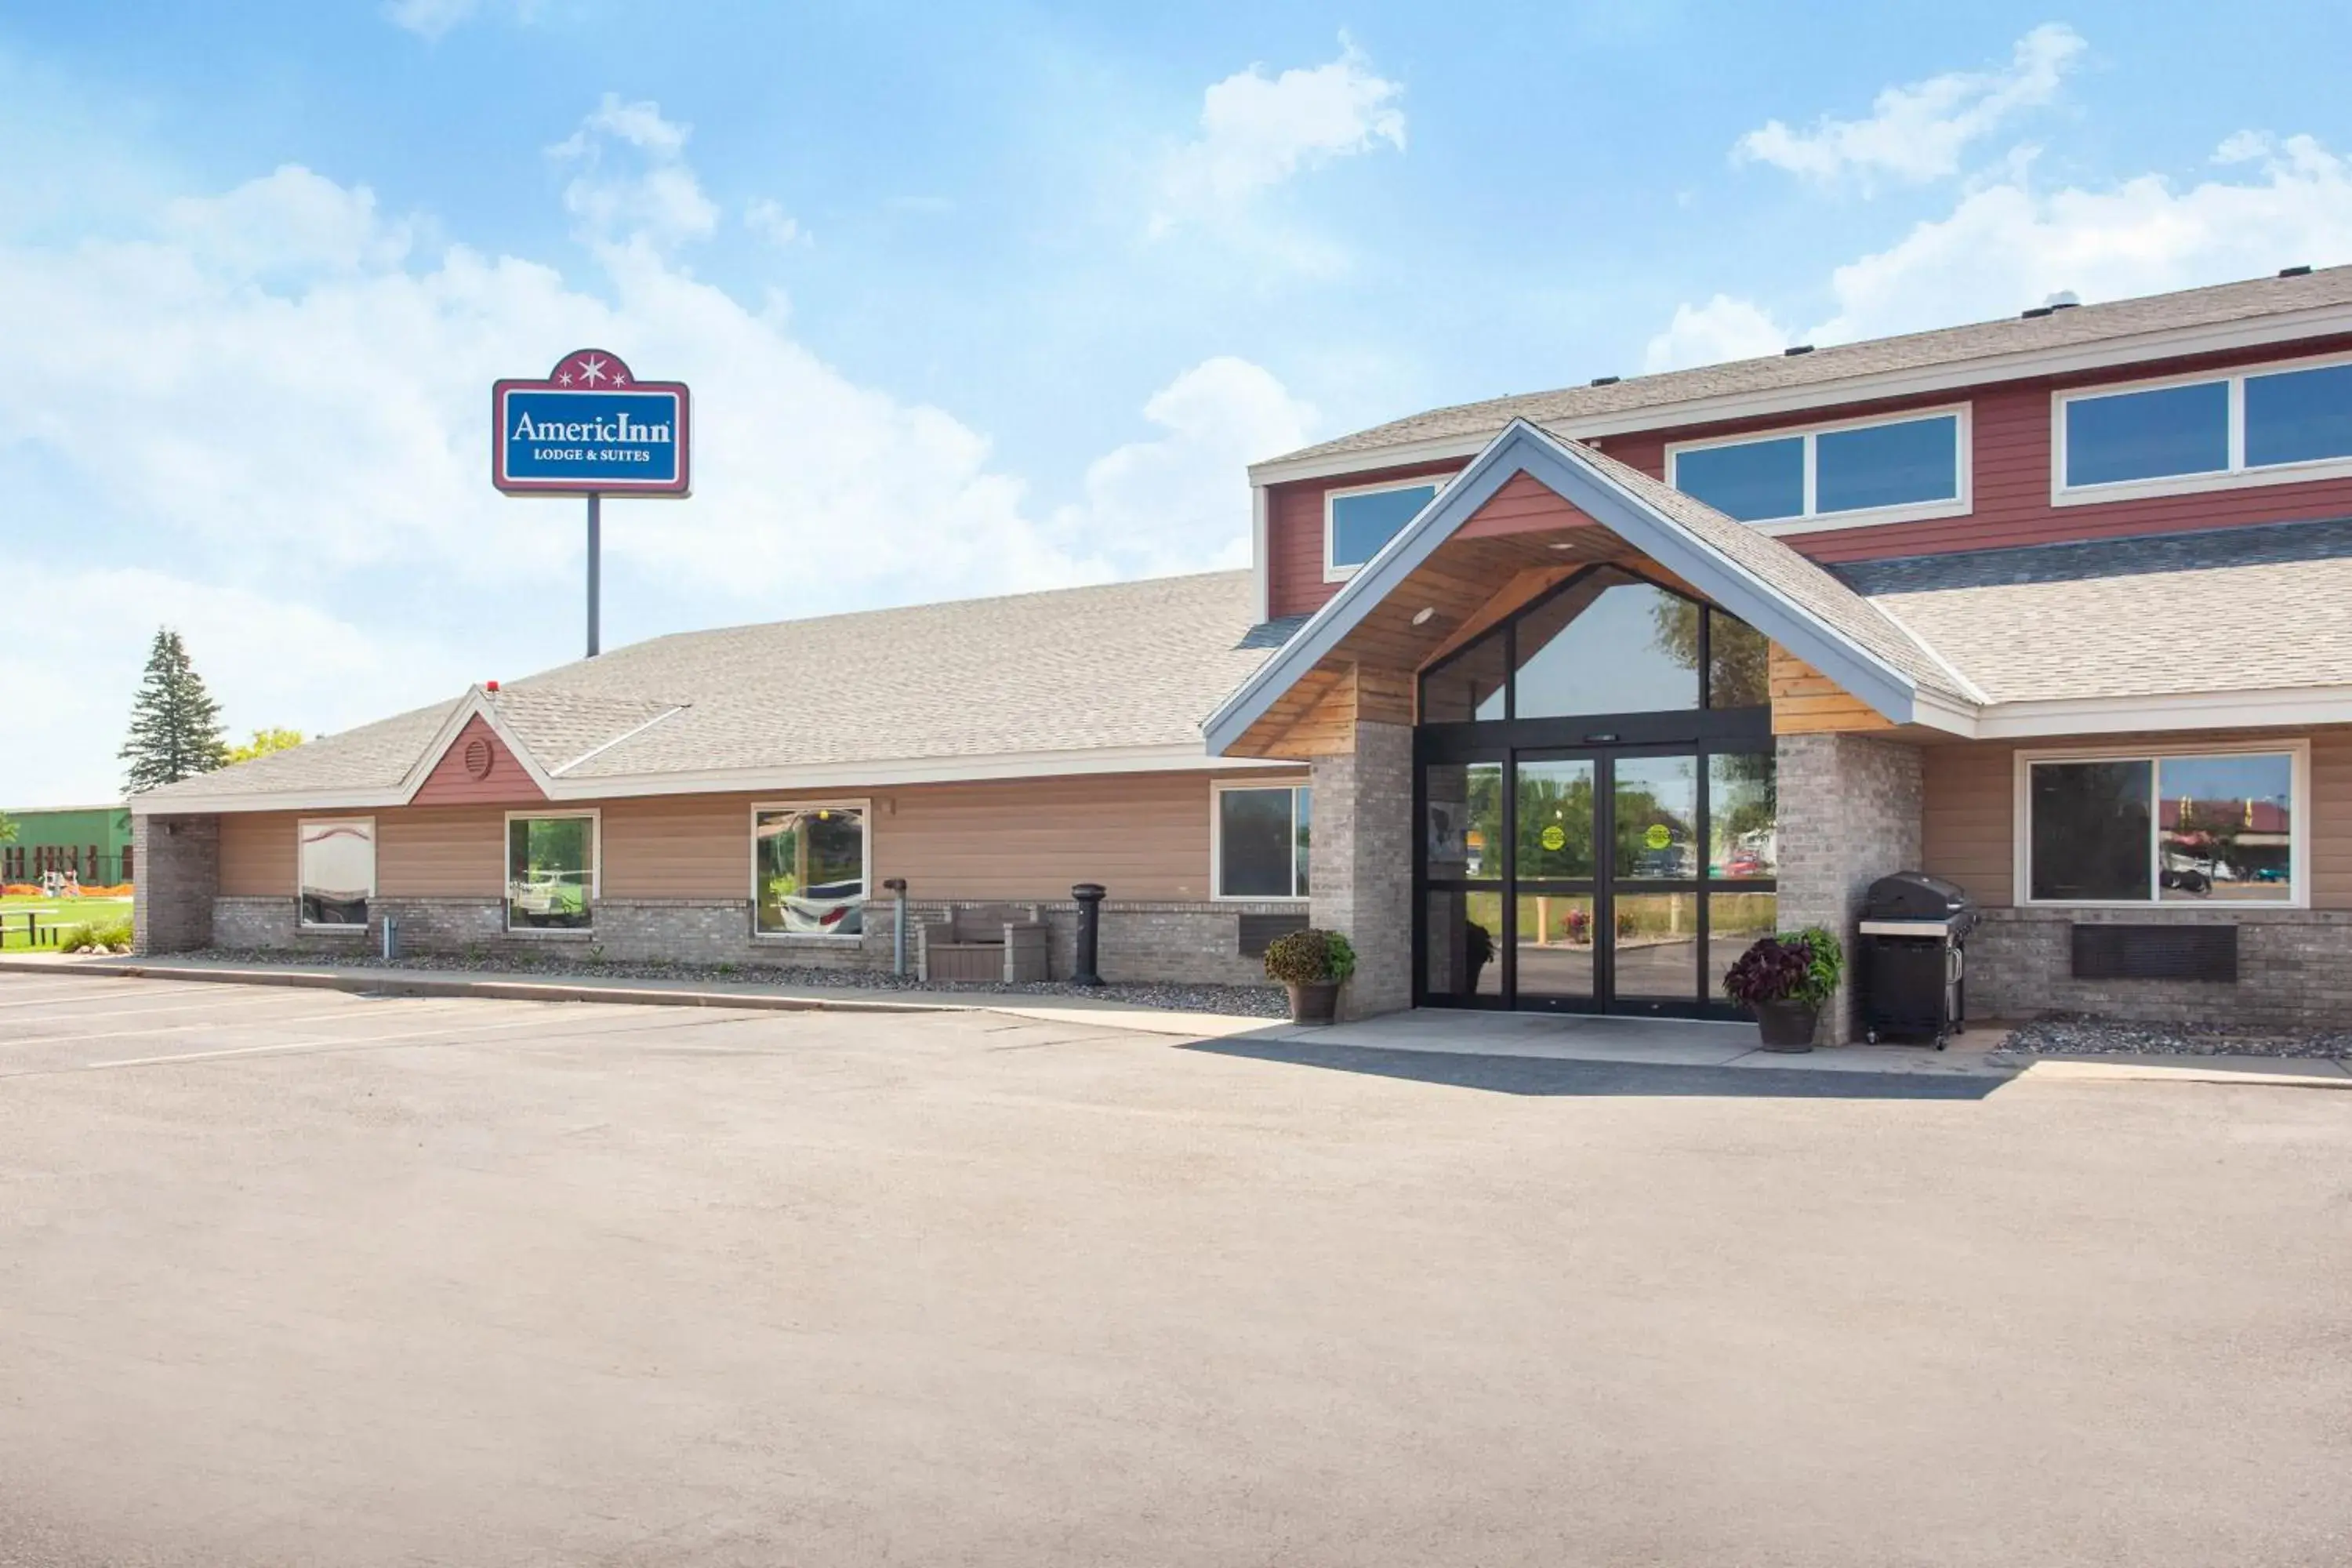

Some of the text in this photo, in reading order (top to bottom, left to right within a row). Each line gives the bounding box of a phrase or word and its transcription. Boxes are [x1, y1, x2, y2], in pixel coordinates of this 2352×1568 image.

[512, 412, 670, 443] AmericInn
[534, 448, 650, 462] LODGE & SUITES
